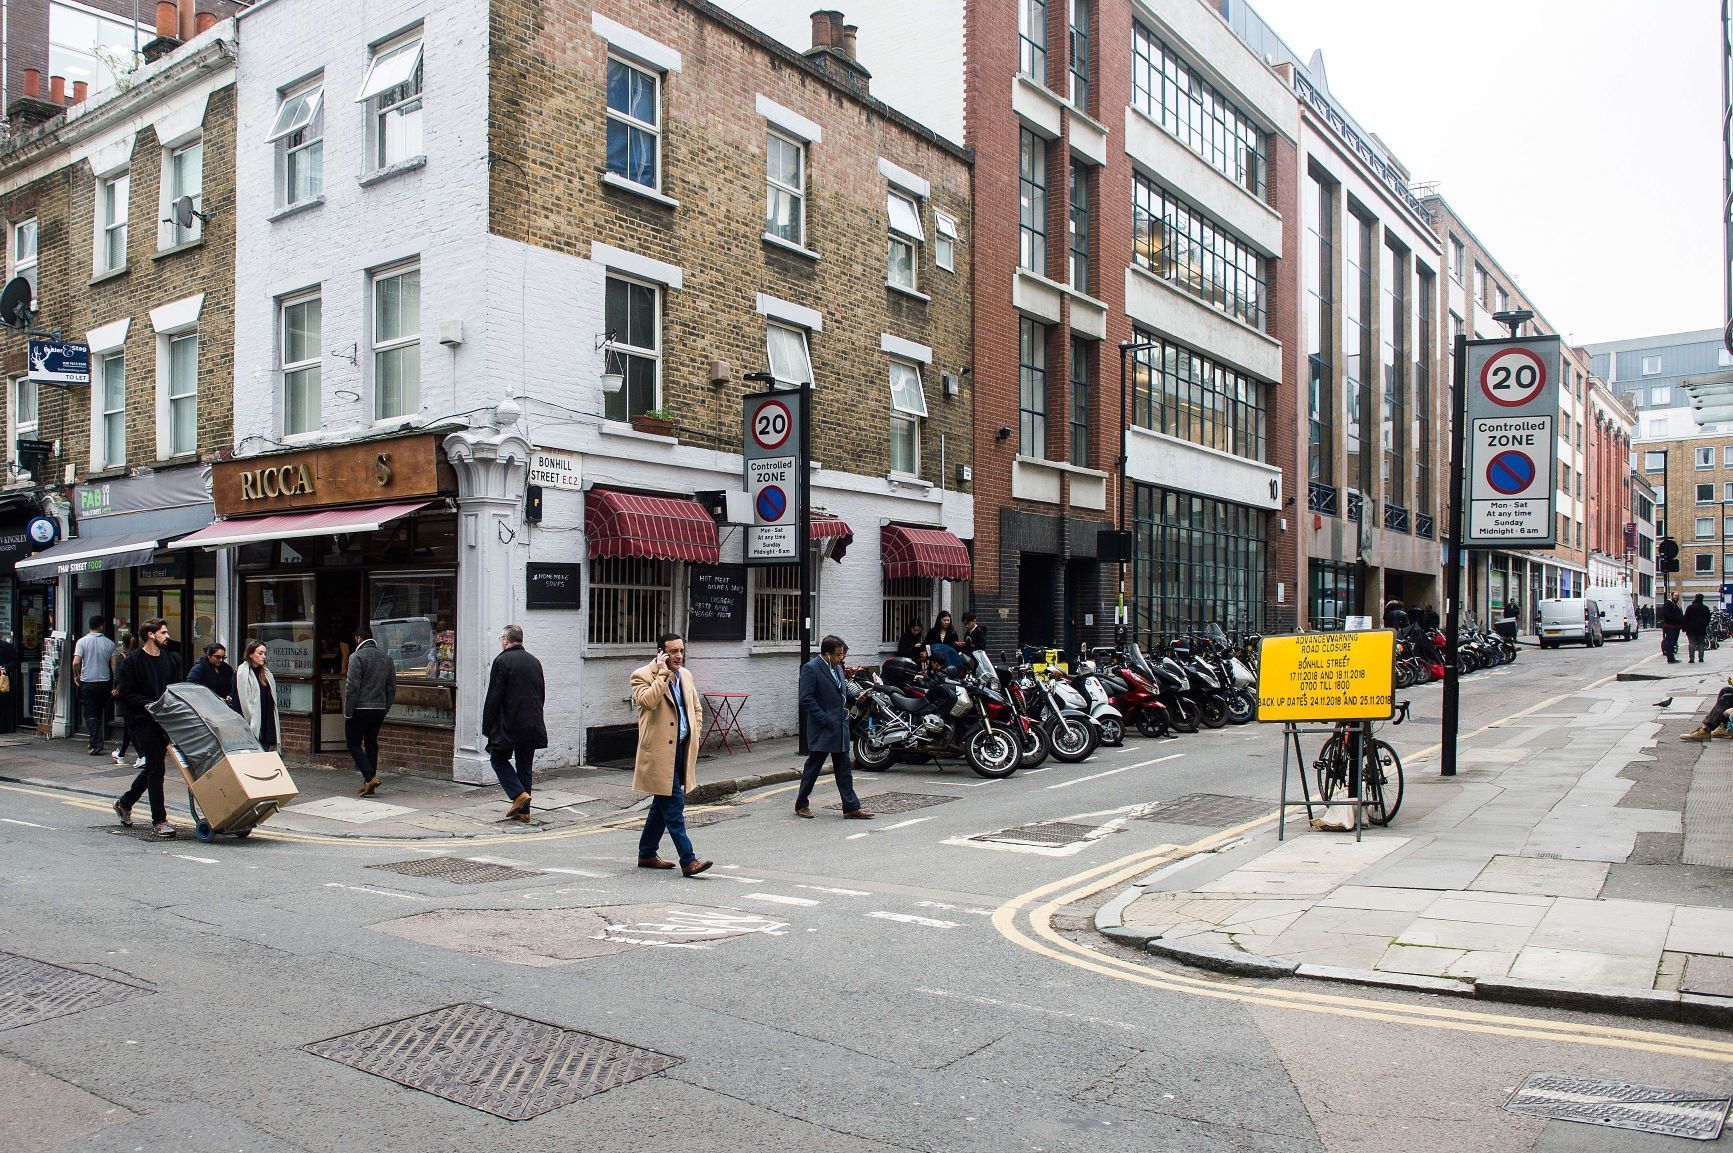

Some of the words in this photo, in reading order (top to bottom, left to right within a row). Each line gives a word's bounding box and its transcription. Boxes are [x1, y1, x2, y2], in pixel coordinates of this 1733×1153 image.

[1493, 365, 1536, 389] 20
[759, 414, 785, 435] 20
[1478, 421, 1545, 432] Controlled
[1488, 434, 1534, 447] ZONE
[539, 456, 572, 470] BONHILL
[751, 460, 792, 471] Controlled
[239, 464, 316, 500] RICCA
[531, 470, 560, 483] STREET
[757, 472, 785, 482] ZONE
[1269, 479, 1278, 500] 10
[81, 489, 101, 508] FAB
[70, 562, 87, 572] STREET
[272, 647, 302, 656] MEETINGS
[1302, 645, 1320, 653] ROAD
[1322, 643, 1351, 652] CLOSURE
[1298, 660, 1324, 669] BONHILL
[1327, 658, 1350, 668] STREET
[1290, 671, 1318, 680] 17.11.2018
[1320, 671, 1334, 680] AND
[1300, 682, 1317, 691] 0700
[1320, 682, 1331, 690] TILL
[1334, 681, 1350, 690] 1800
[1259, 698, 1274, 707] BACK
[1277, 698, 1284, 706] UP
[1287, 697, 1307, 706] DATES
[1310, 696, 1341, 706] 24.11.2018
[1344, 696, 1357, 705] AND
[1360, 695, 1392, 705] 25.11.2018
